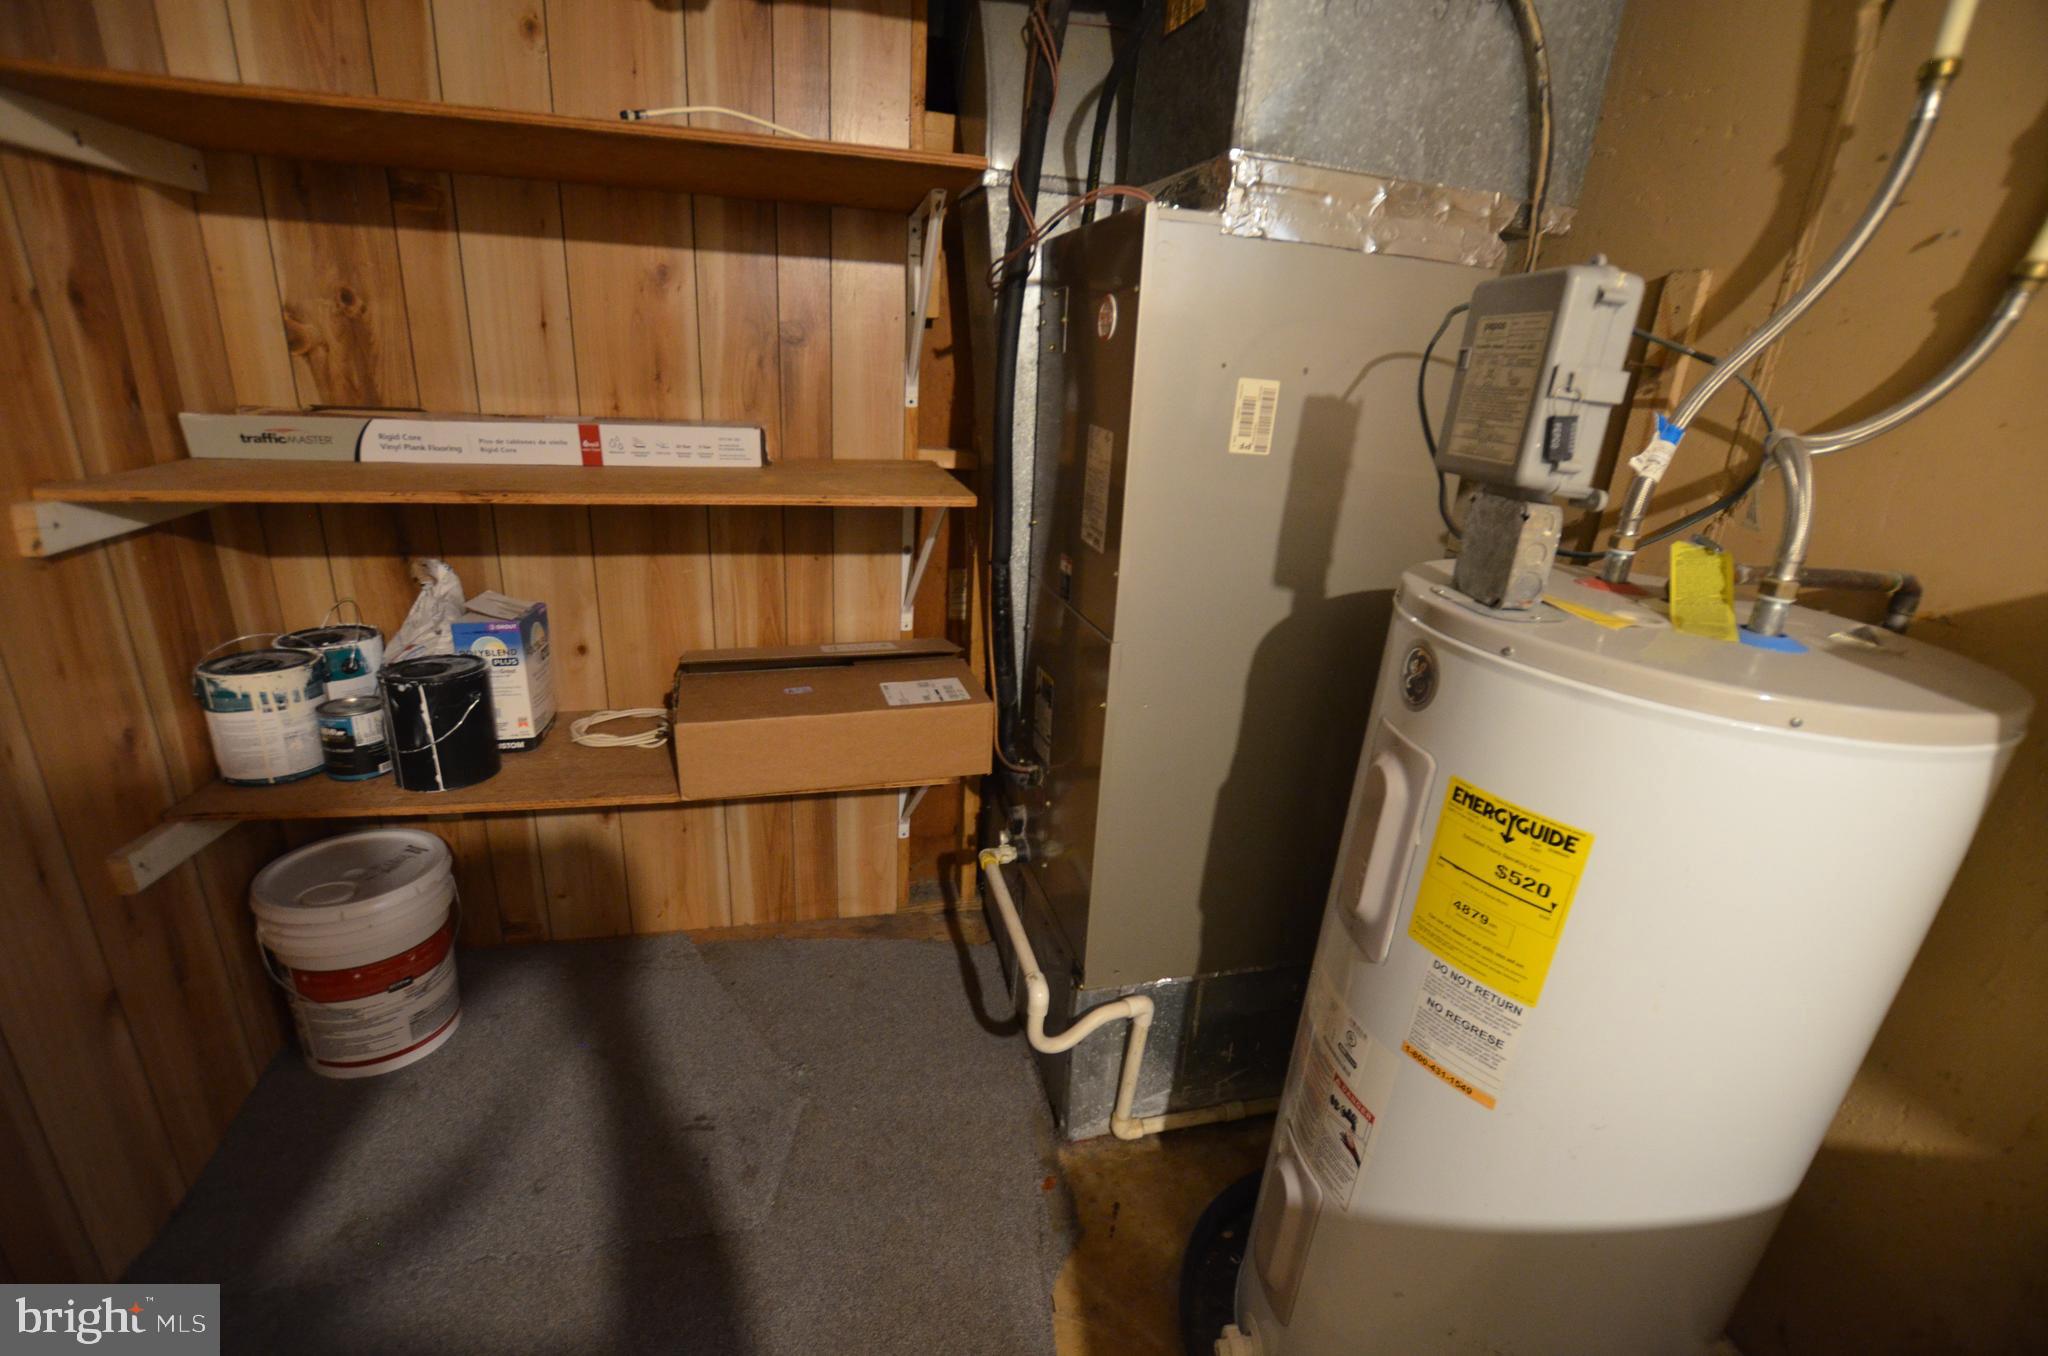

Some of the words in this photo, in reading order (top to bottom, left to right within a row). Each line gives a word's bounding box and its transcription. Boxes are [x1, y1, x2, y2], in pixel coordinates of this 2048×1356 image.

[240, 432, 333, 446] trafficMASTER
[378, 432, 400, 443] Rigid
[401, 432, 422, 442] Core
[380, 443, 402, 453] Vinyl
[403, 443, 426, 452] Plank
[428, 444, 463, 454] Flooring
[480, 446, 499, 455] Rigid
[500, 446, 517, 454] Core
[1452, 785, 1580, 853] ENERGYGUIDE
[1494, 864, 1552, 898] $520
[1452, 900, 1490, 925] 4879
[1432, 959, 1449, 975] DO
[1450, 970, 1473, 989] NOT
[1473, 984, 1524, 1016] RETURN
[1426, 997, 1444, 1013] NO
[1445, 1009, 1505, 1049] REGRESE
